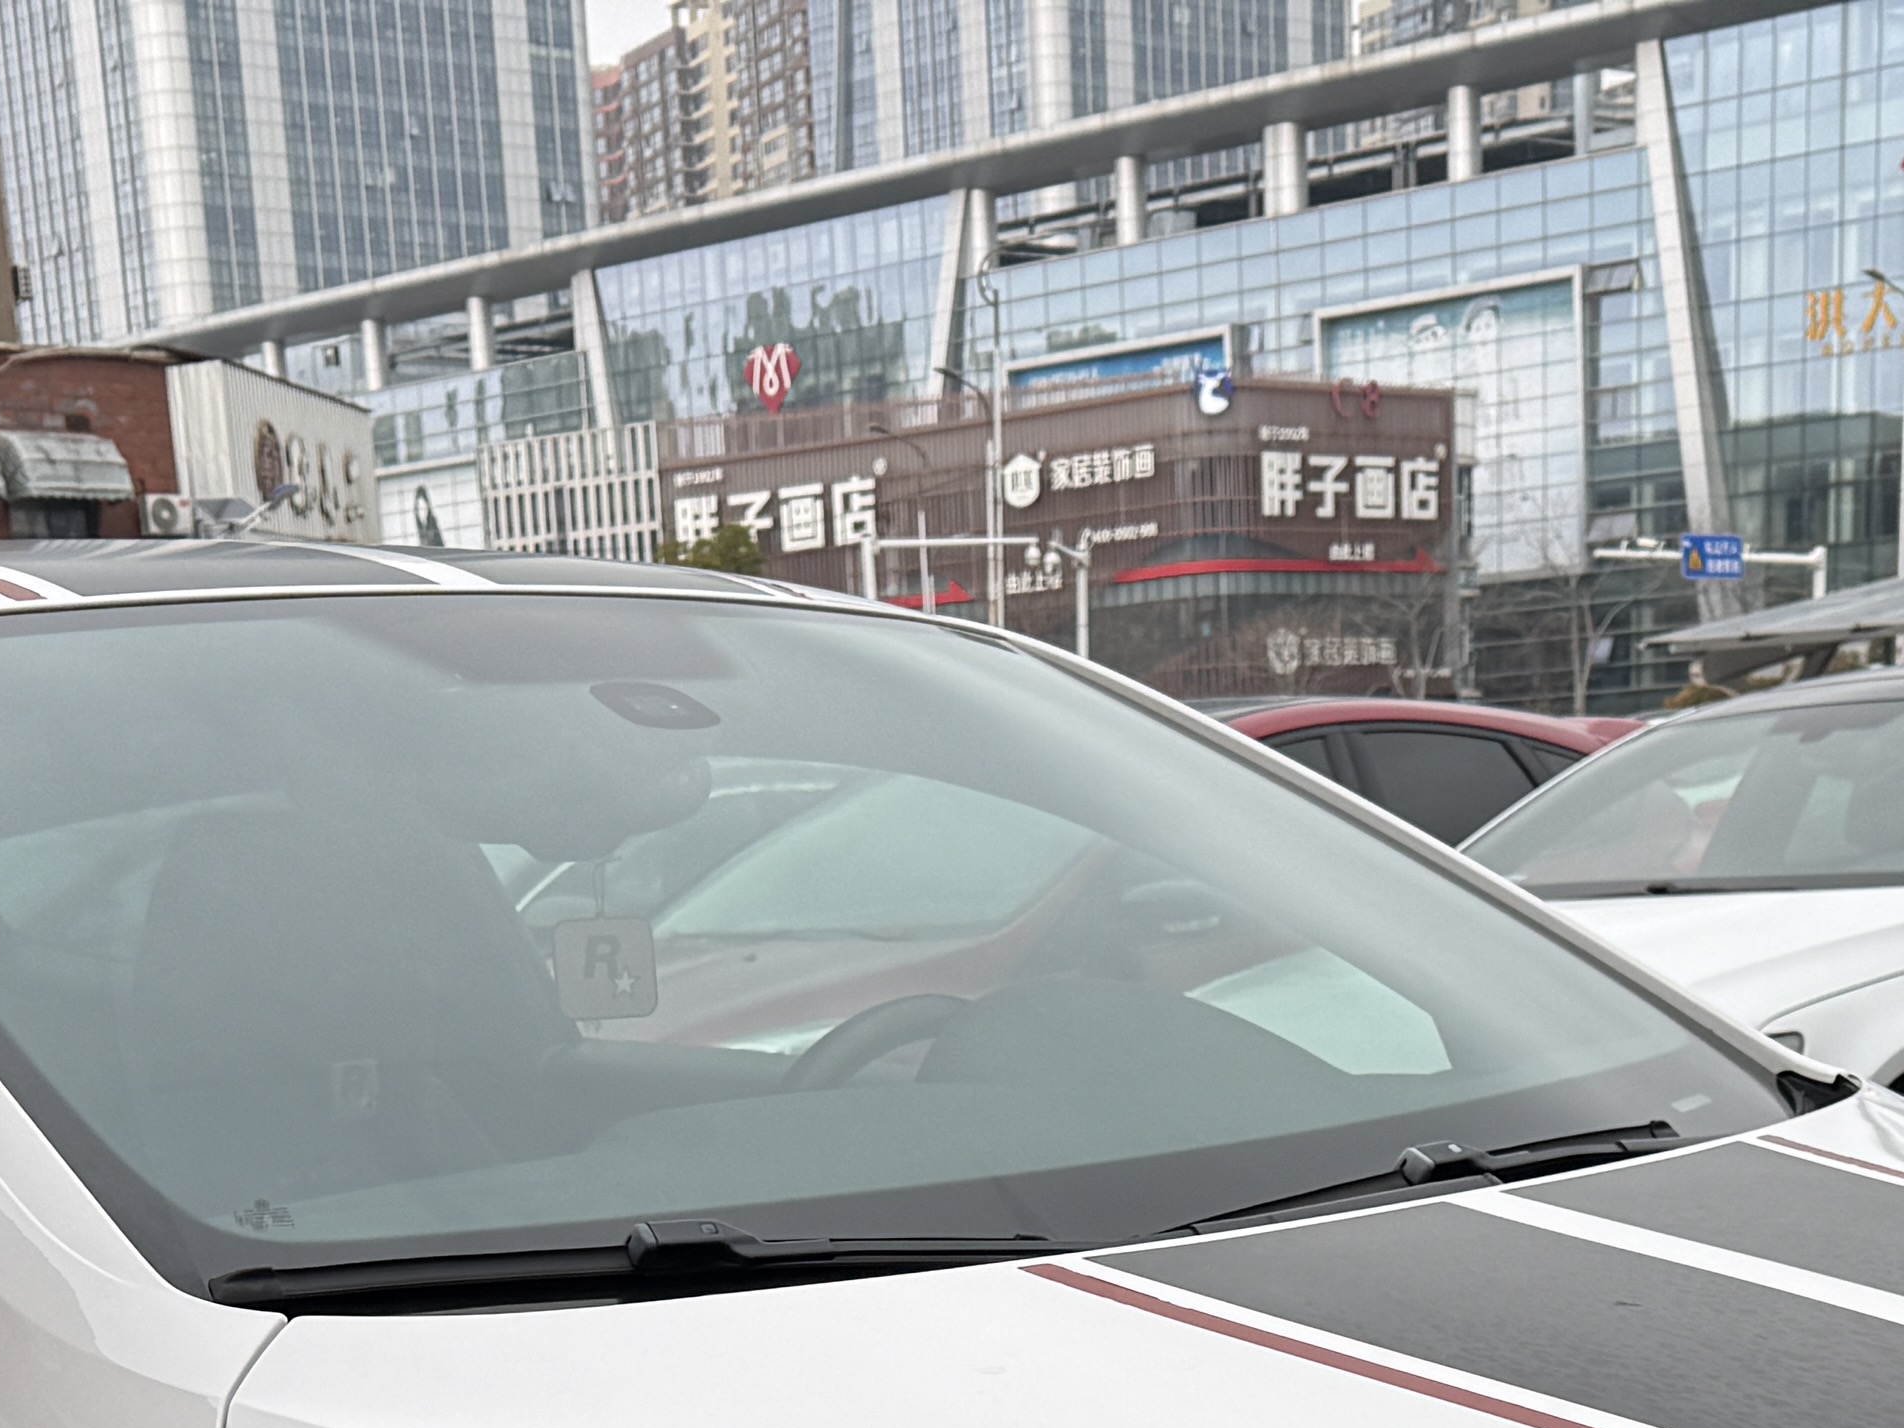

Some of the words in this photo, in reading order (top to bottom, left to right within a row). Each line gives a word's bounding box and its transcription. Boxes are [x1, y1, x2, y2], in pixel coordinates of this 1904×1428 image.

[1050, 444, 1155, 490] 家居装饰画
[1261, 451, 1439, 519] 胖子画店
